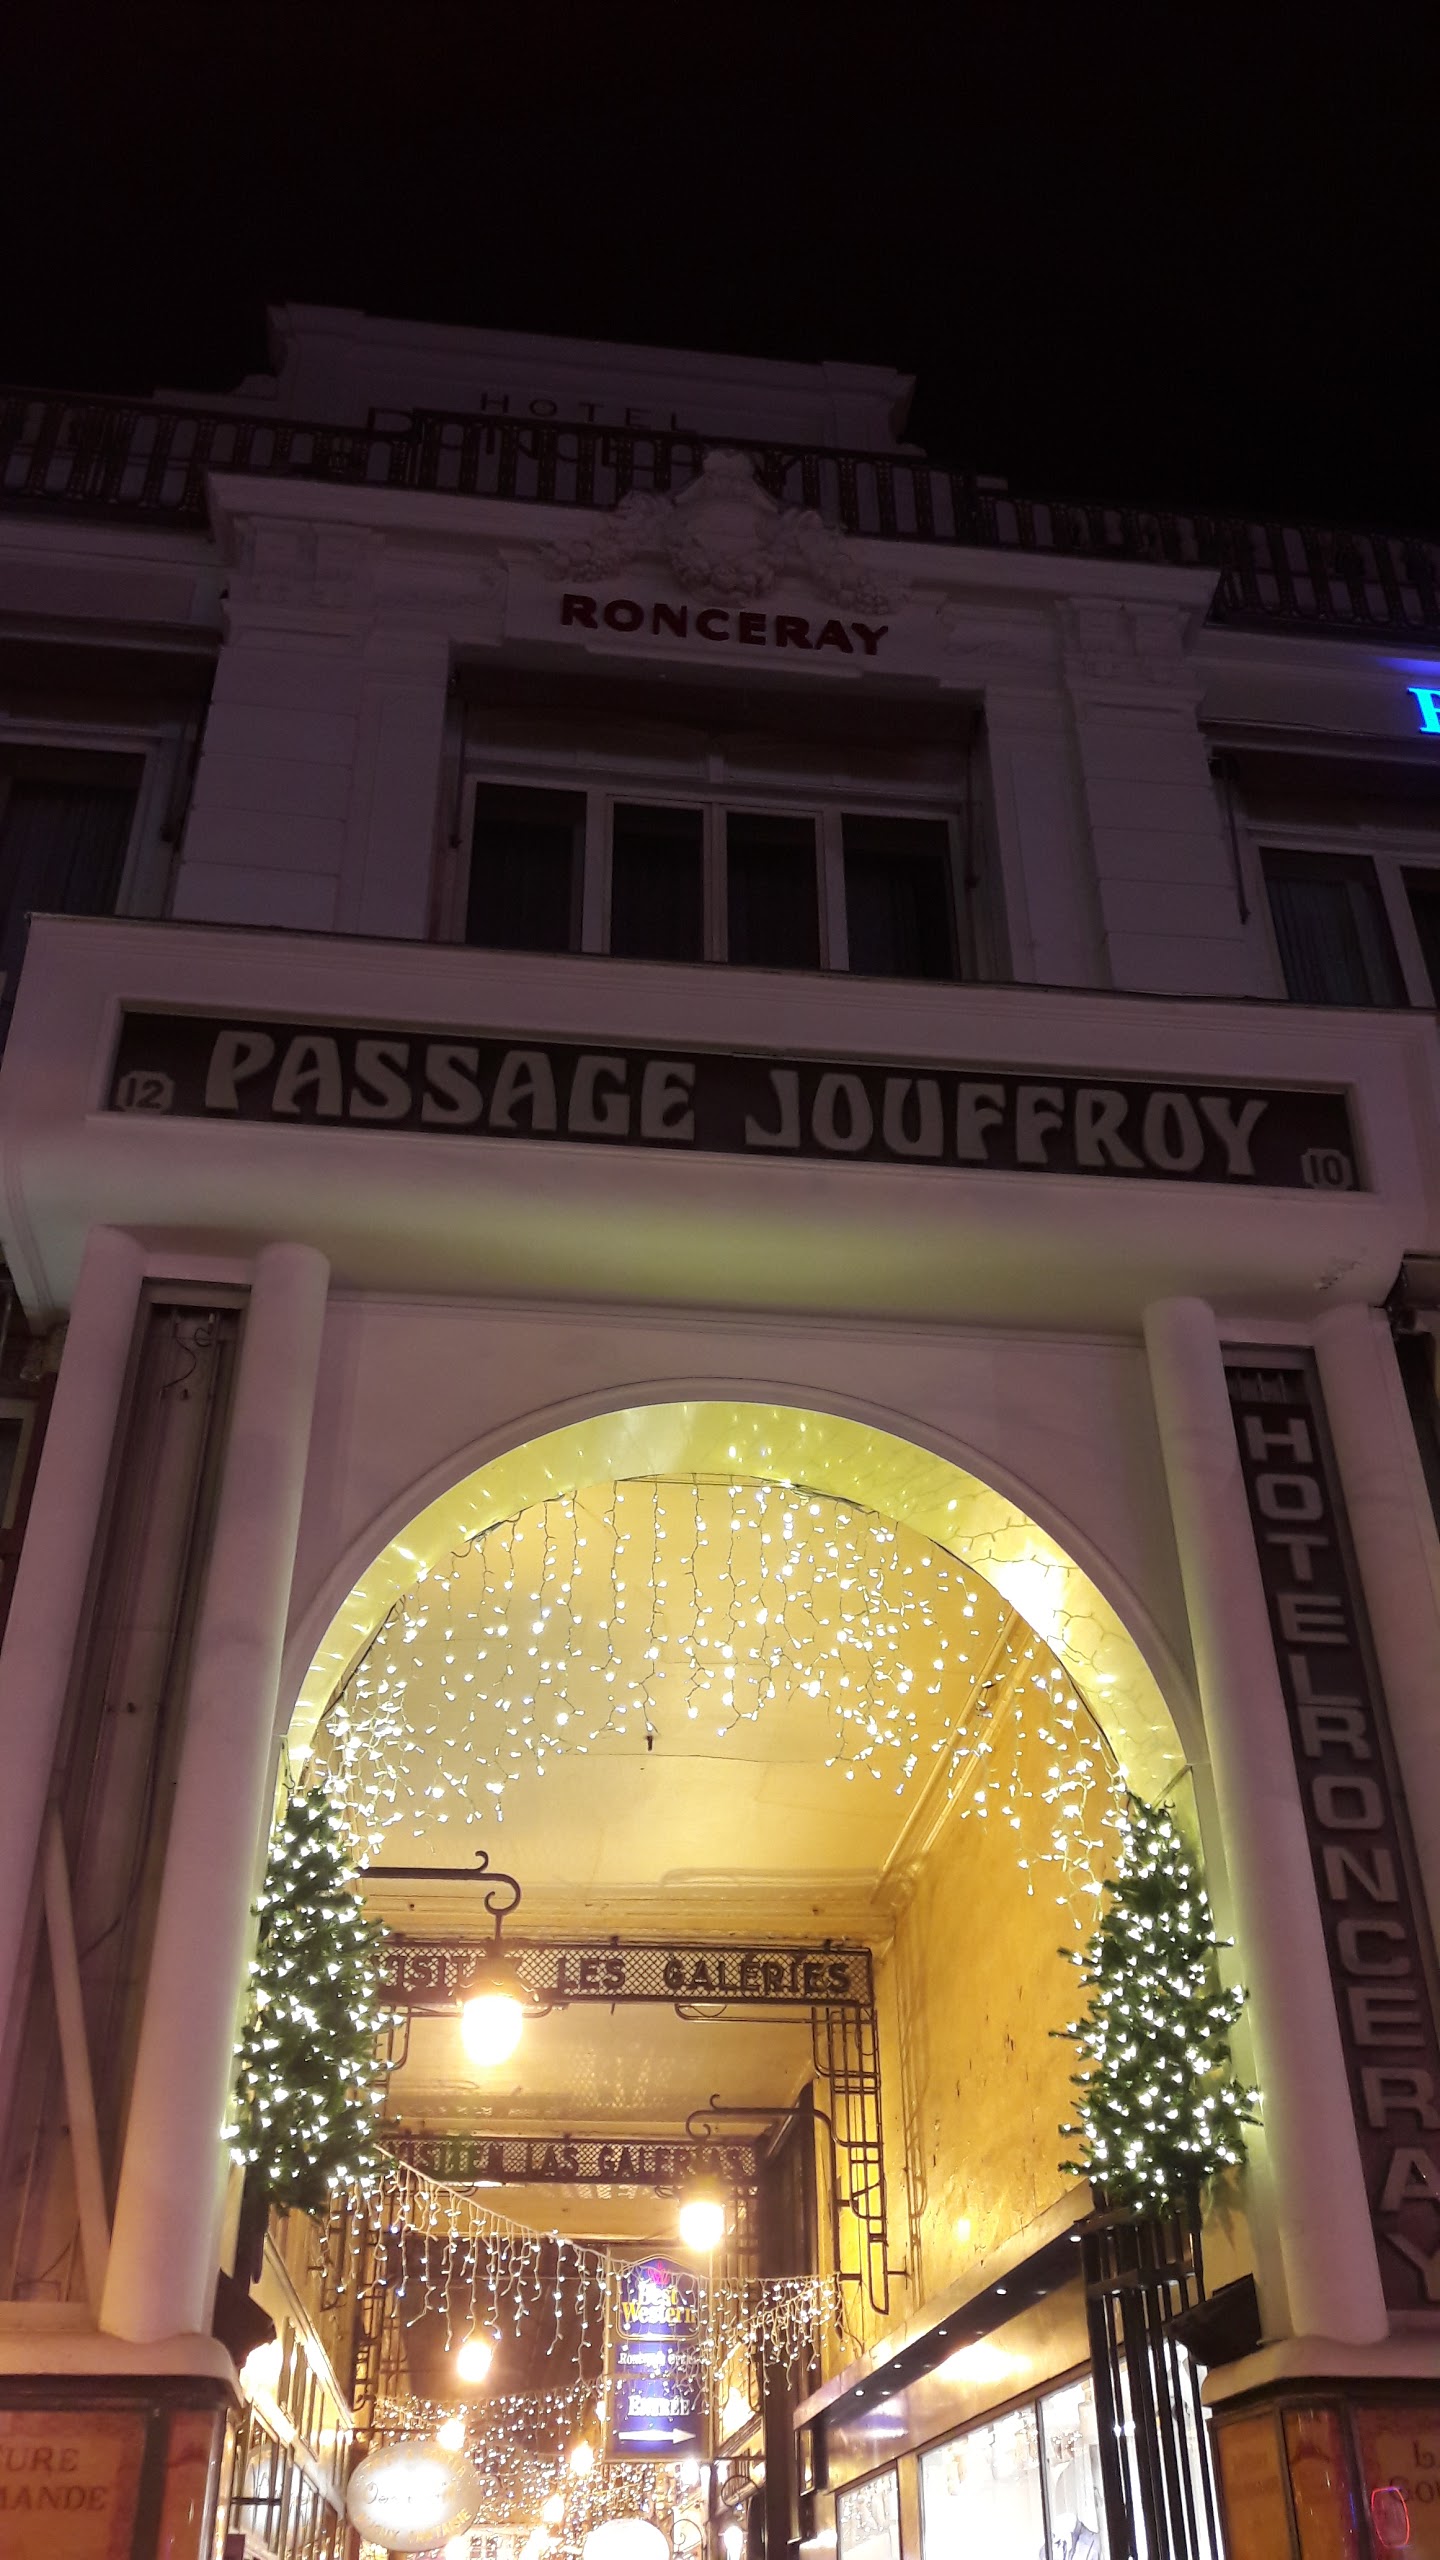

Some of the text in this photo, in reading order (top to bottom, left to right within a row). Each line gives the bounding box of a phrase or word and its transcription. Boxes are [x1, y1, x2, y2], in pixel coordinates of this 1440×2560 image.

[480, 393, 697, 433] HOTEL
[561, 593, 889, 656] RONCERAY
[125, 1077, 164, 1110] 12
[204, 1029, 1269, 1178] PASSAGE JOUFFROY
[1309, 1153, 1344, 1187] 10
[1241, 1414, 1366, 1709] HOTEL
[557, 1956, 627, 1991] LES
[662, 1957, 851, 1995] GALERIES
[526, 2142, 581, 2178] LAS
[638, 2280, 678, 2306] Best
[621, 2301, 697, 2324] Western
[0, 2446, 79, 2472] URE
[0, 2485, 108, 2511] ANDE
